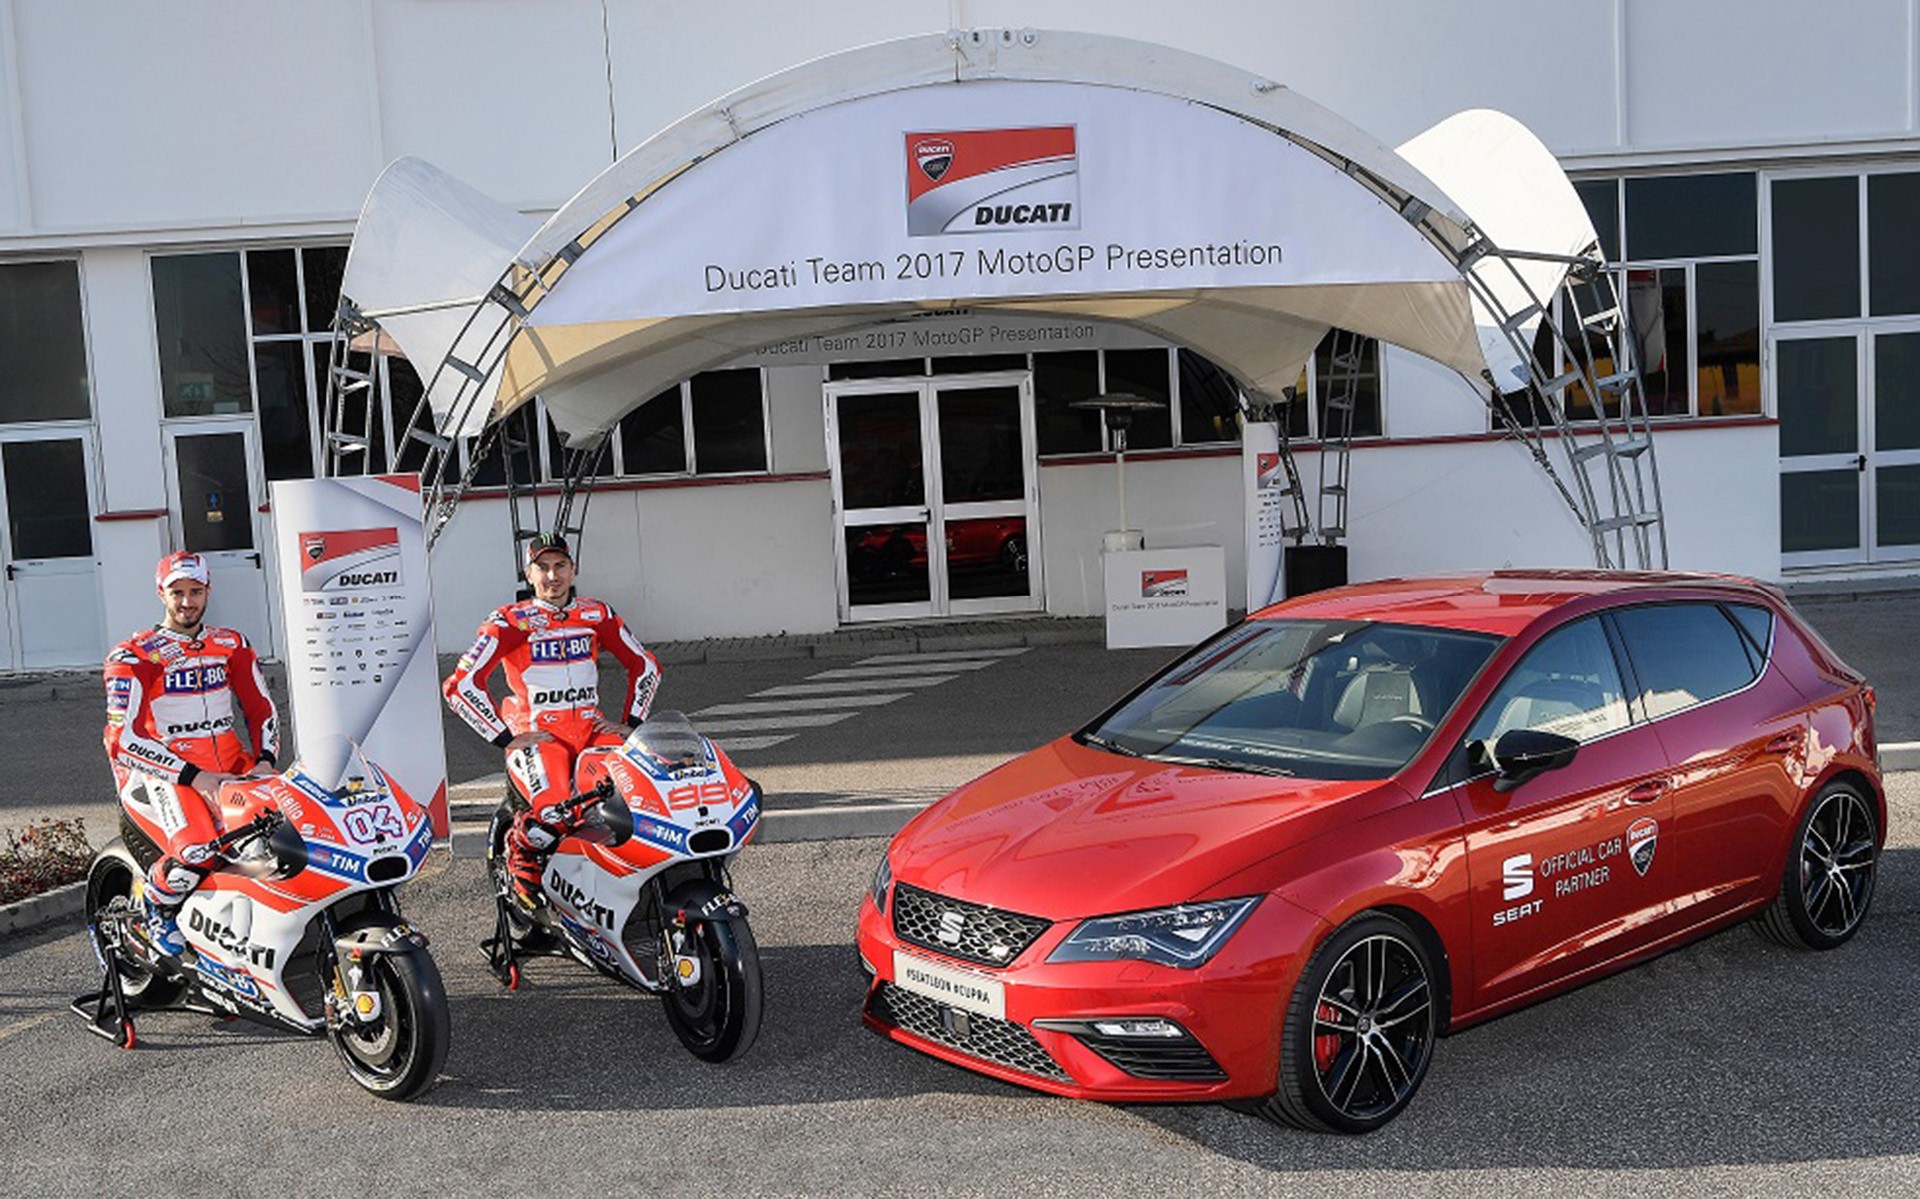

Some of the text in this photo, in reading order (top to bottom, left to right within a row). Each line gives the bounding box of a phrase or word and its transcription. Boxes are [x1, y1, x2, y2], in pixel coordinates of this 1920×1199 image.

[975, 203, 1072, 225] DUCATI
[705, 239, 1283, 292] Ducati Team 2017 MotoGP Presentation
[813, 335, 860, 351] Team
[865, 331, 906, 349] 2017
[913, 327, 984, 347] MotoGP
[990, 323, 1094, 342] Presentation
[339, 571, 398, 586] DUCATI
[463, 690, 497, 723] DUCATI
[128, 743, 175, 766] DUCATI
[344, 806, 403, 844] 04
[655, 825, 683, 845] TIM
[331, 854, 361, 873] TIM
[1540, 847, 1596, 877] OFFICIAL
[1598, 837, 1622, 860] CAR
[1555, 866, 1610, 898] PARTNER
[550, 868, 615, 931] DUCATI
[1493, 899, 1543, 926] SEAT
[189, 907, 276, 970] DUCATI
[906, 968, 991, 1004] #SEATLEON #CUPRA
